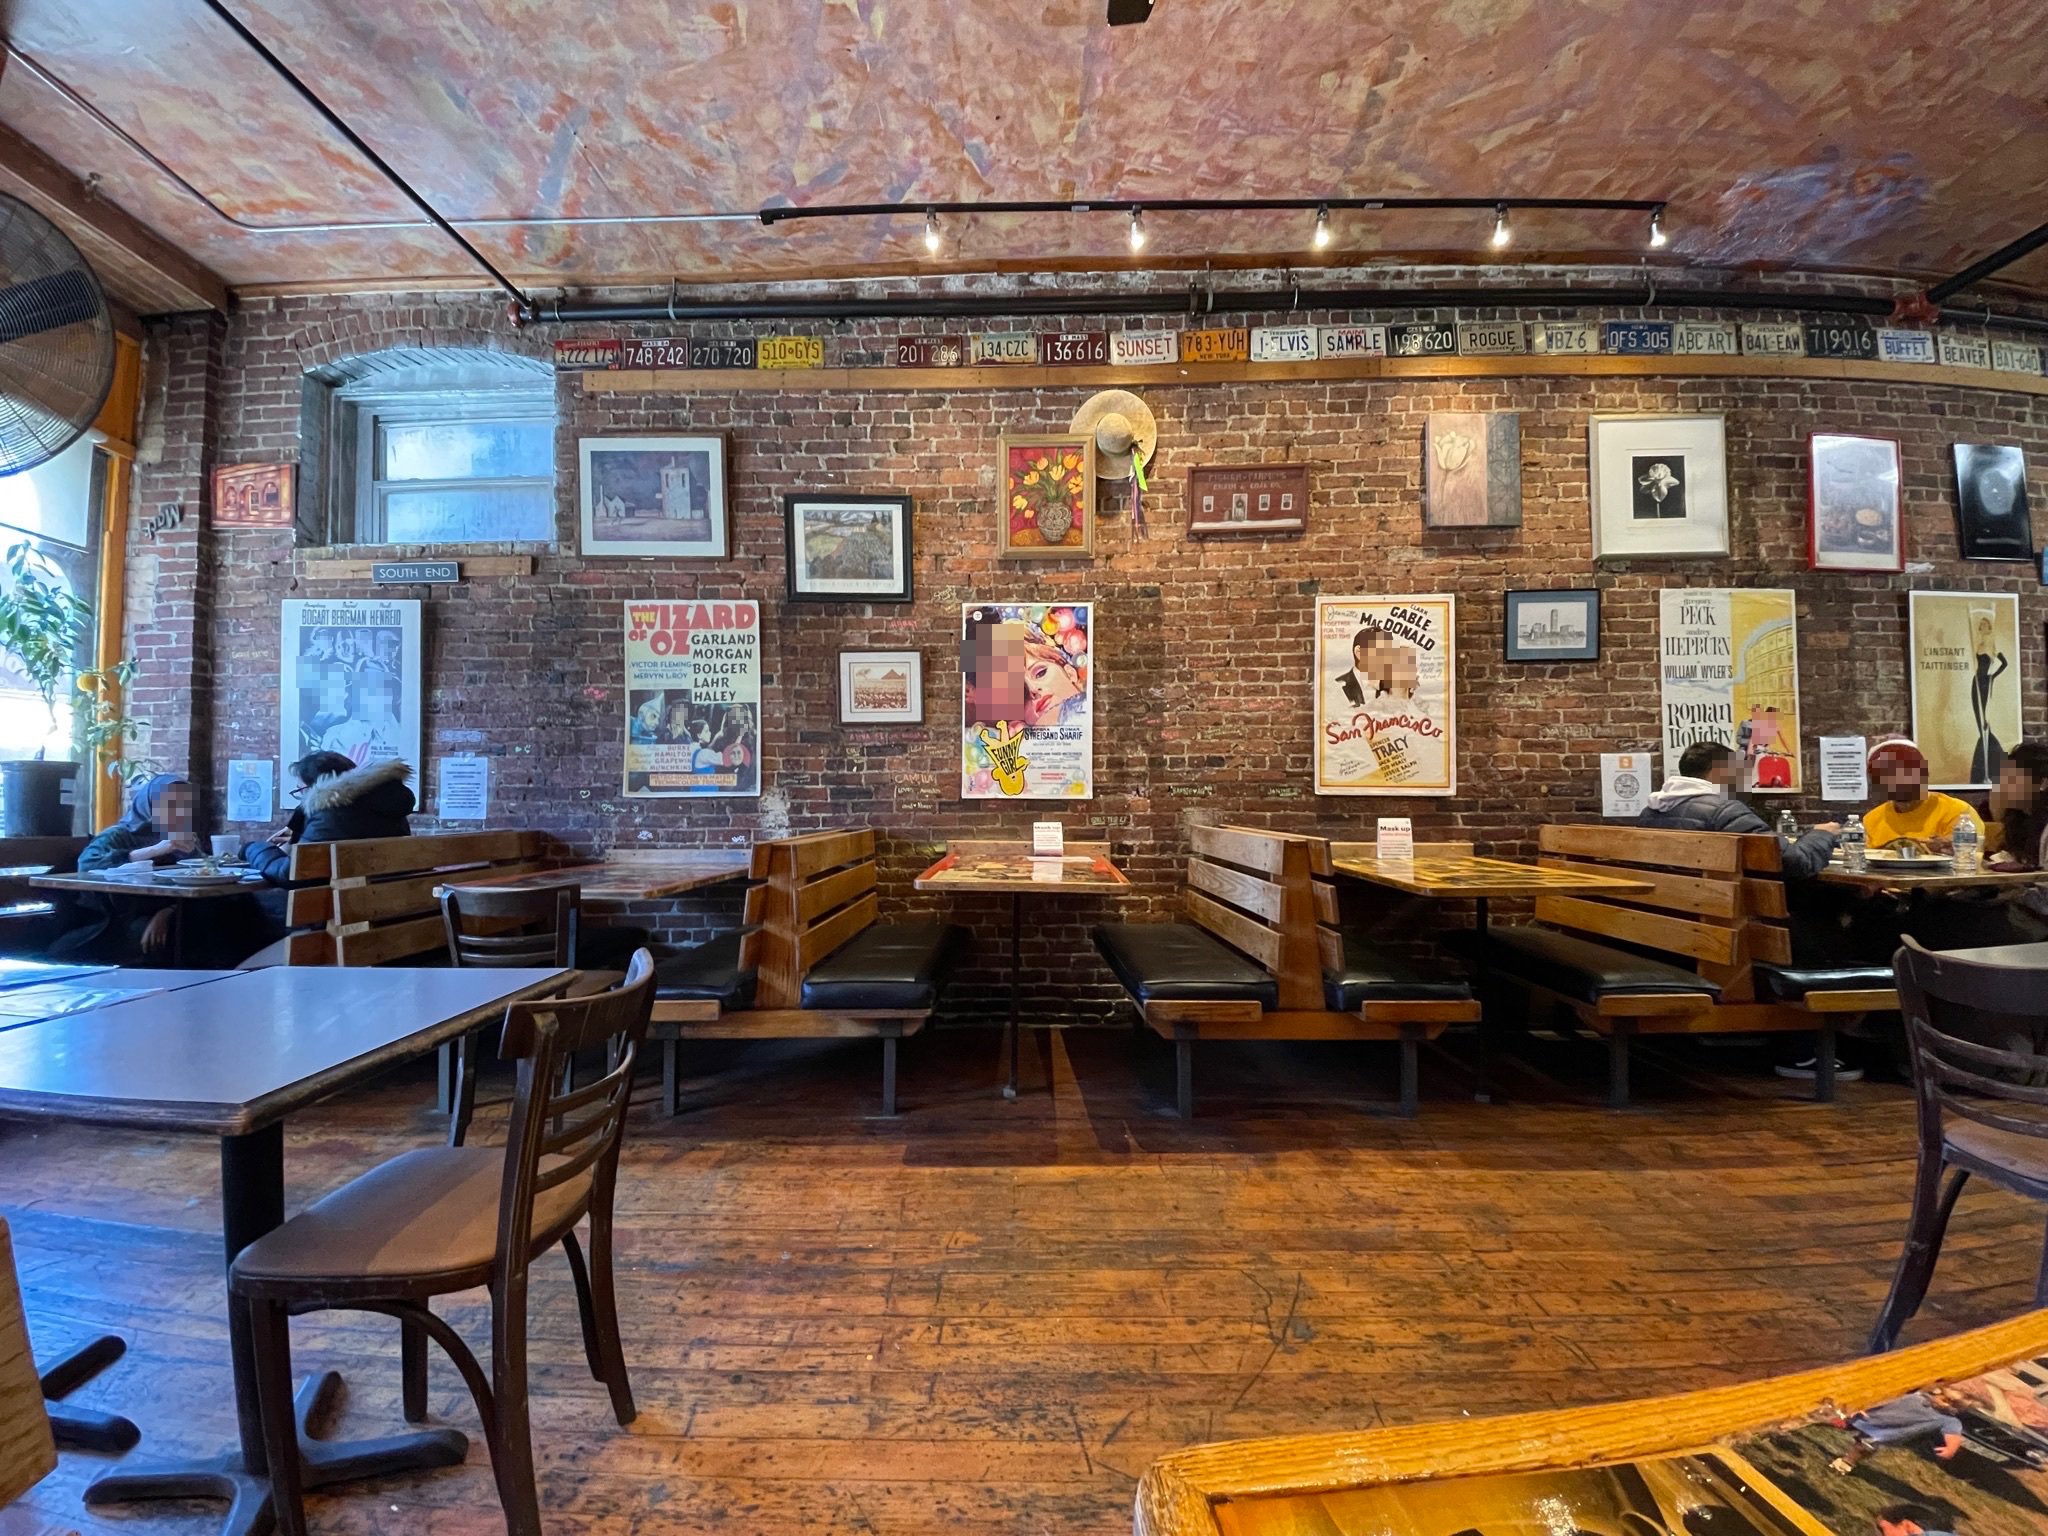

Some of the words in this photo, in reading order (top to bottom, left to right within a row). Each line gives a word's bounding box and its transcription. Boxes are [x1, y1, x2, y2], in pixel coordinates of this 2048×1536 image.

[1327, 333, 1382, 351] SAMPLE
[1469, 331, 1516, 347] ROGUE
[1117, 338, 1172, 357] SUNSET
[1885, 341, 1927, 356] BUFFET
[1944, 346, 1985, 366] BEAVER
[379, 567, 419, 579] SOUTH
[425, 567, 451, 578] END
[302, 609, 330, 626] BOGART
[331, 609, 367, 625] BERGMAN
[370, 609, 402, 625] HENREID
[629, 604, 757, 631] WIZARD
[632, 611, 656, 622] THE
[1410, 604, 1429, 616] CLARK
[1680, 606, 1717, 626] PECK
[1390, 606, 1433, 631] GABLE
[628, 630, 648, 641] OF
[650, 630, 691, 656] OZ
[691, 634, 756, 645] GARLAND
[1665, 637, 1731, 656] HEPBURN
[693, 649, 753, 660] MORGAN
[1923, 647, 1965, 657] L'INSTANT
[632, 661, 659, 669] VICTOR
[660, 661, 693, 669] FLEMING
[693, 663, 748, 674] BOLGER
[1664, 665, 1698, 680] WILLIAM
[1701, 665, 1733, 680] WYLER'S
[1920, 661, 1970, 671] TAITTINGER
[634, 672, 664, 680] MERVYN
[694, 677, 729, 688] LAHR
[694, 691, 736, 702] HALEY
[1667, 703, 1733, 729] Roman
[1024, 728, 1058, 741] STREISAND
[1060, 728, 1083, 741] SHARIF
[1326, 721, 1361, 744] San
[991, 738, 1022, 762] FUNNY
[1372, 736, 1409, 761] TRACY
[1000, 755, 1018, 776] GIRL
